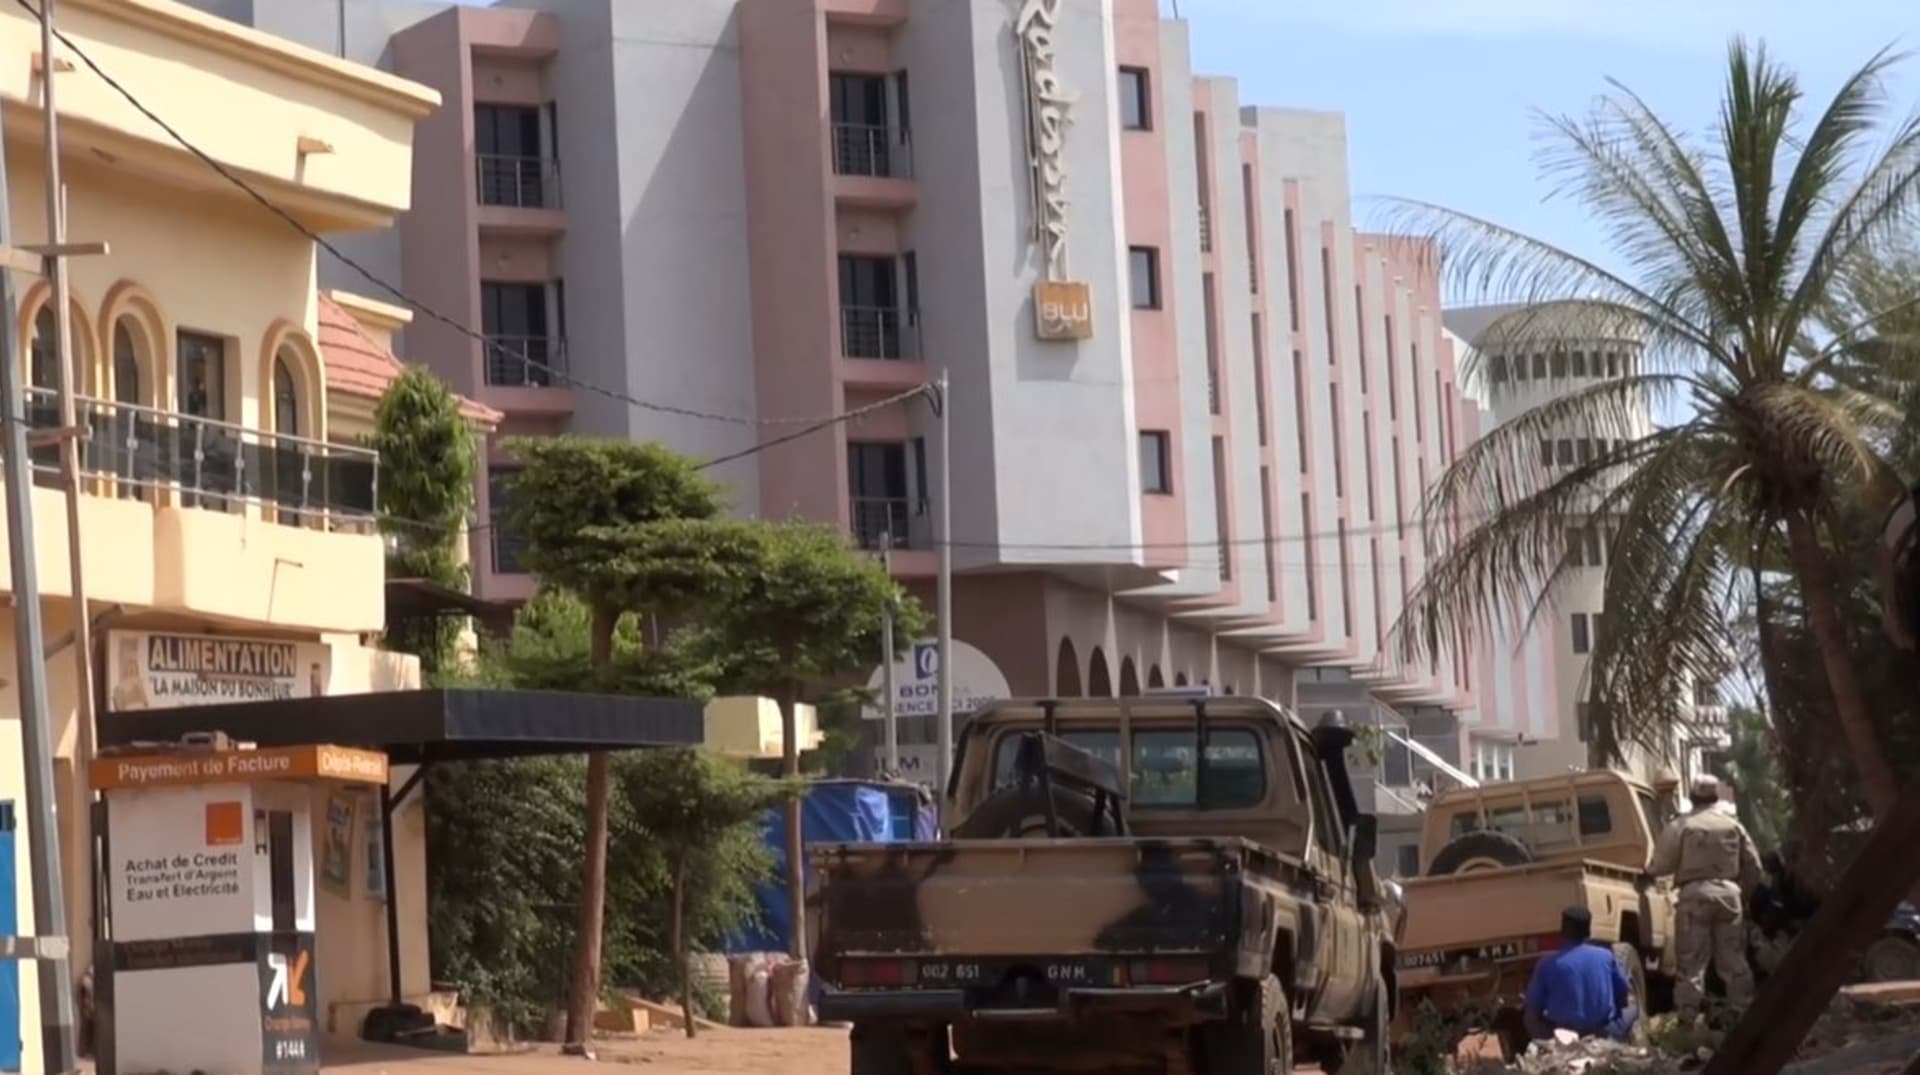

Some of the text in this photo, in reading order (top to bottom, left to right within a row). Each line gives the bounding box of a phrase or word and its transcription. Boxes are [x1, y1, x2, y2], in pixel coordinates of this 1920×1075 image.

[1042, 302, 1089, 322] BLU
[150, 636, 296, 676] ALIMENTATION
[171, 677, 218, 696] MAISON
[221, 679, 237, 697] DU
[117, 754, 290, 783] Payement de Facture
[125, 852, 238, 872] Achat de Credit
[126, 868, 238, 886] Transfert d'Argent
[126, 887, 153, 902] Eau
[156, 886, 170, 899] et
[921, 963, 950, 979] 002
